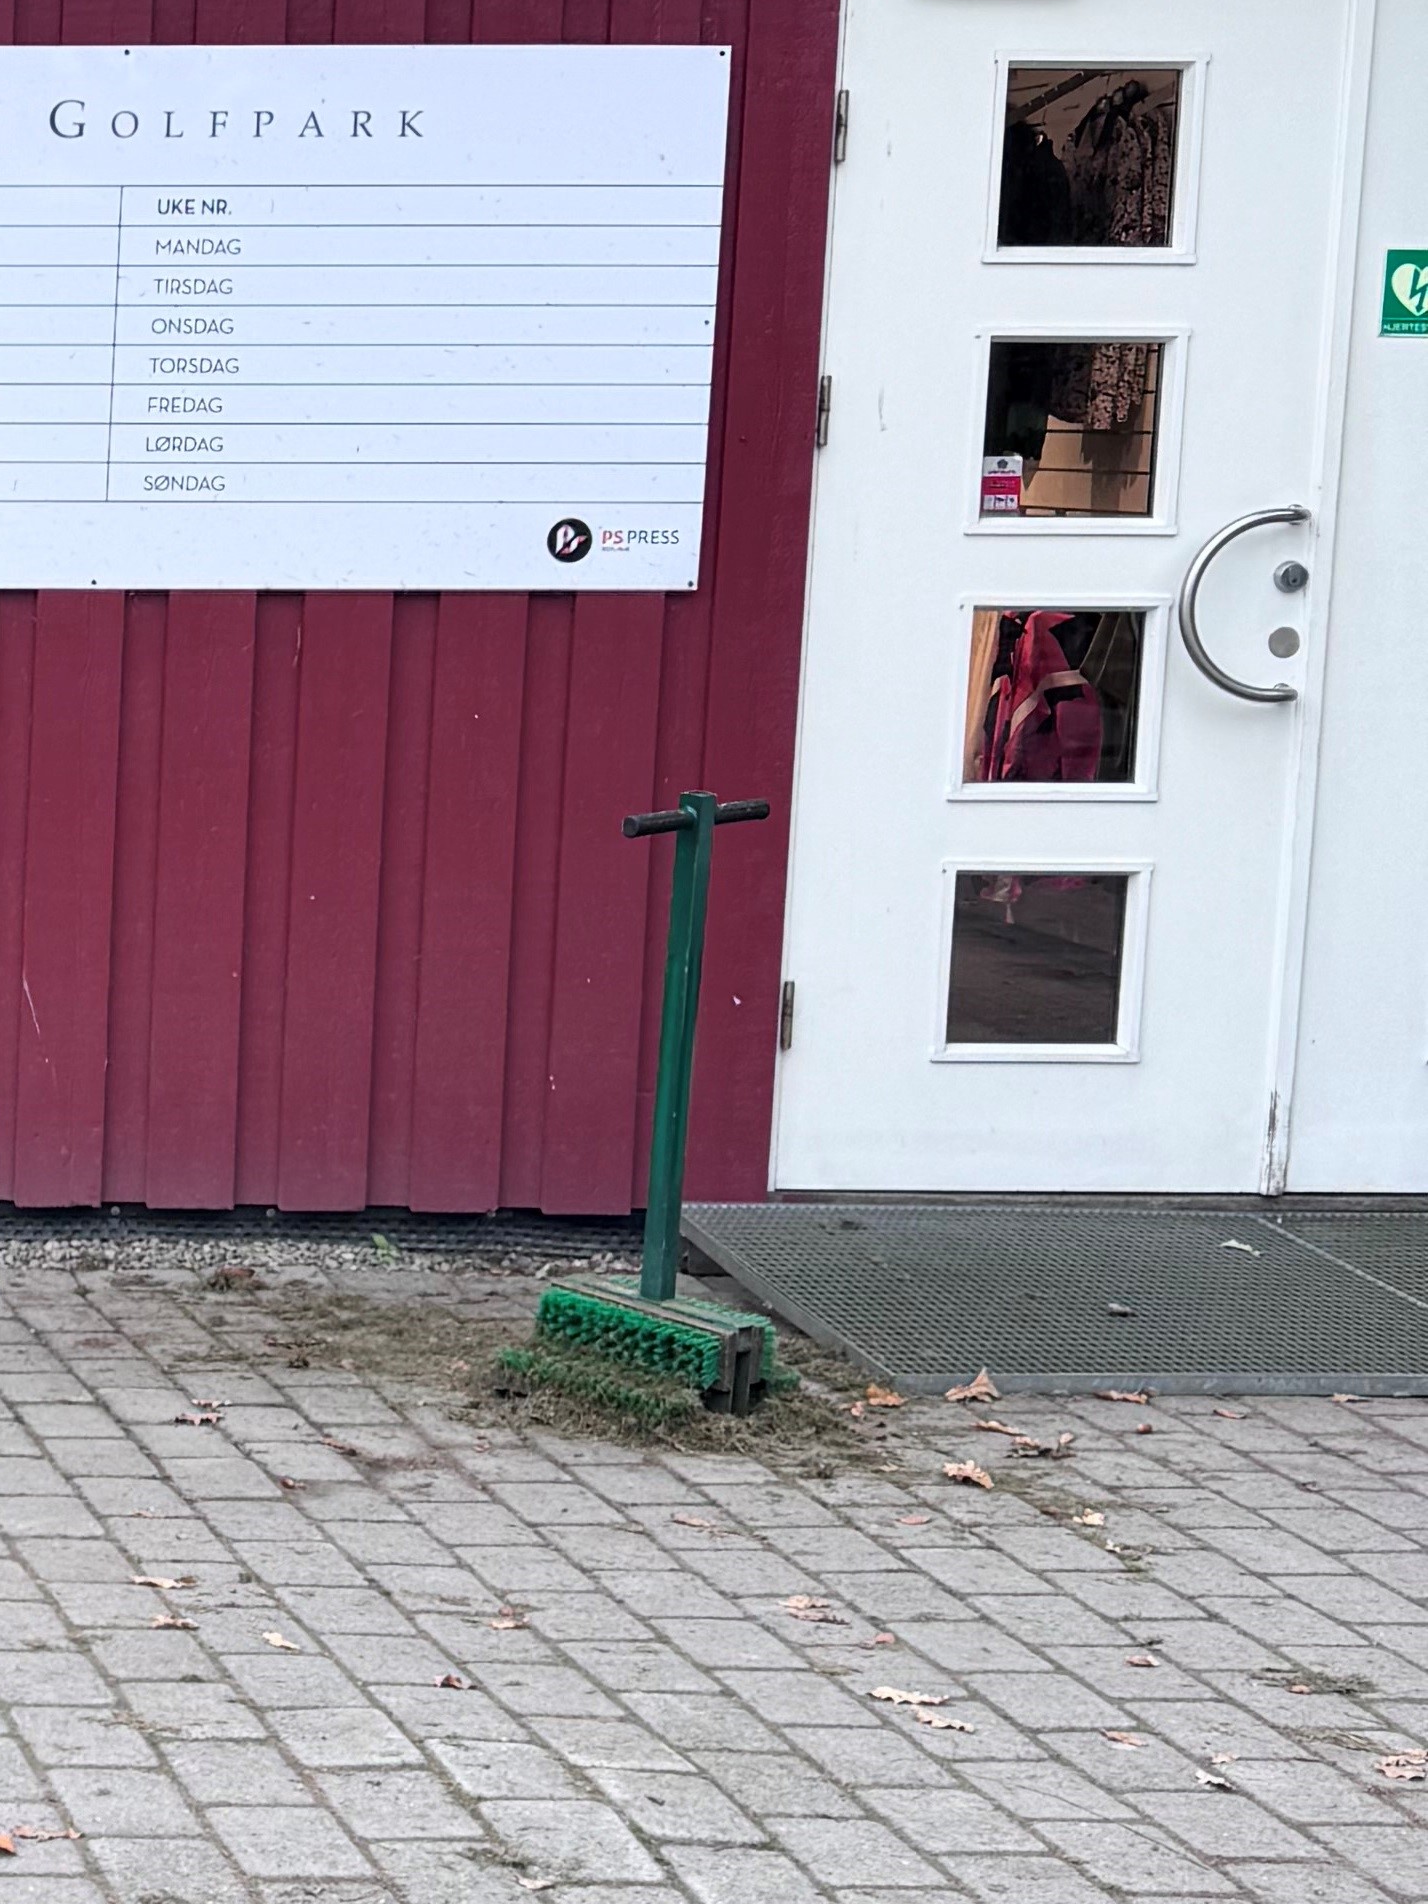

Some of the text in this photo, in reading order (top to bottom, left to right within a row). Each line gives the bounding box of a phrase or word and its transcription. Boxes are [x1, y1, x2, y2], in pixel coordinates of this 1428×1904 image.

[49, 99, 424, 139] GOLFPARK
[157, 198, 233, 215] UKE NR.
[155, 238, 242, 255] MANDAG
[153, 278, 234, 295] TIRSDAG
[151, 318, 234, 335] ONSDAG
[149, 357, 240, 374] TORSDAG
[147, 397, 223, 414] FREDAG
[145, 436, 224, 453] LØRDAG
[143, 475, 226, 492] SØNDAG
[601, 529, 680, 545] PS PRESS
